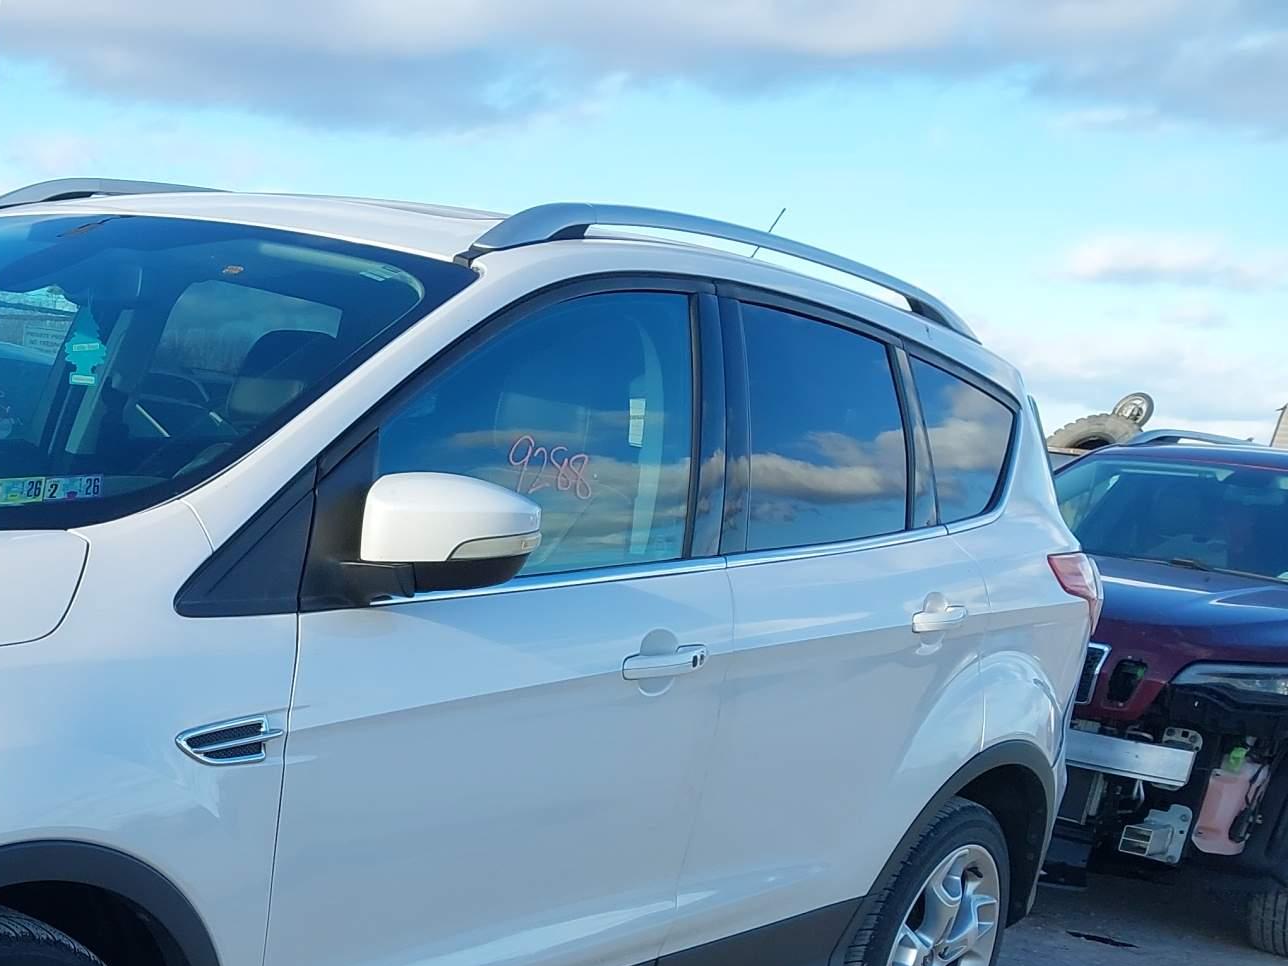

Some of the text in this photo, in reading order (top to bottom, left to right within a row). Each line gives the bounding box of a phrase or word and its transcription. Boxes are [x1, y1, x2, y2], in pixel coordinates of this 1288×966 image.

[509, 435, 591, 499] 9288
[26, 480, 43, 498] 26
[48, 478, 100, 499] 2 26
